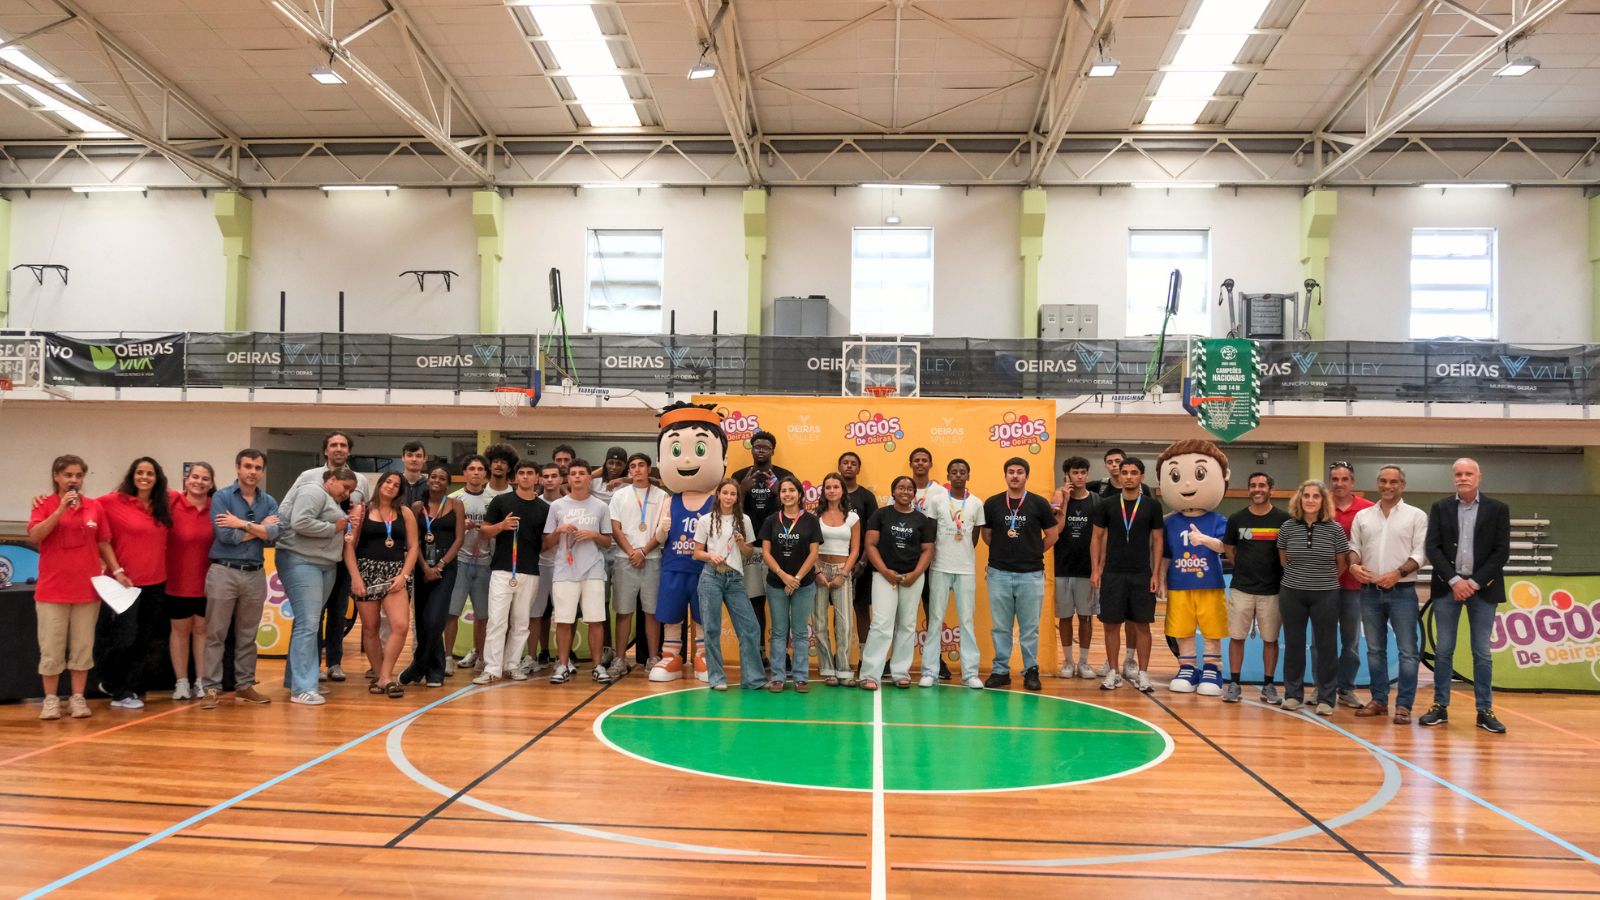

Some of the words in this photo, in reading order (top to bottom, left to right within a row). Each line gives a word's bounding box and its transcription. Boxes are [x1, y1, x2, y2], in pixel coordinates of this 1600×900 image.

[119, 358, 153, 370] VIVA
[226, 351, 281, 365] OEIRAS
[304, 352, 361, 366] VALLEY
[416, 354, 473, 368] OEIRAS
[604, 355, 664, 369] OEIRAS
[689, 355, 748, 369] VALLEY
[807, 357, 868, 371] OEIRAS
[1014, 359, 1077, 373] OEIRAS
[1317, 362, 1382, 376] VALLEY
[1435, 363, 1500, 378] OEIRAS
[1528, 365, 1593, 380] VALLEY
[1212, 374, 1246, 382] NACIONAIS
[787, 424, 821, 433] OEIRAS
[847, 417, 900, 439] JOGOS
[930, 427, 965, 436] OEIRAS
[991, 419, 1045, 441] JOGOS
[856, 438, 867, 446] De
[867, 434, 893, 445] Oeiras
[1000, 440, 1011, 448] De
[1011, 436, 1037, 447] Oeiras
[567, 508, 586, 517] JUST
[578, 517, 590, 525] DO
[672, 541, 696, 550] JOGO
[1175, 558, 1208, 568] JOGOS
[1516, 650, 1541, 665] De
